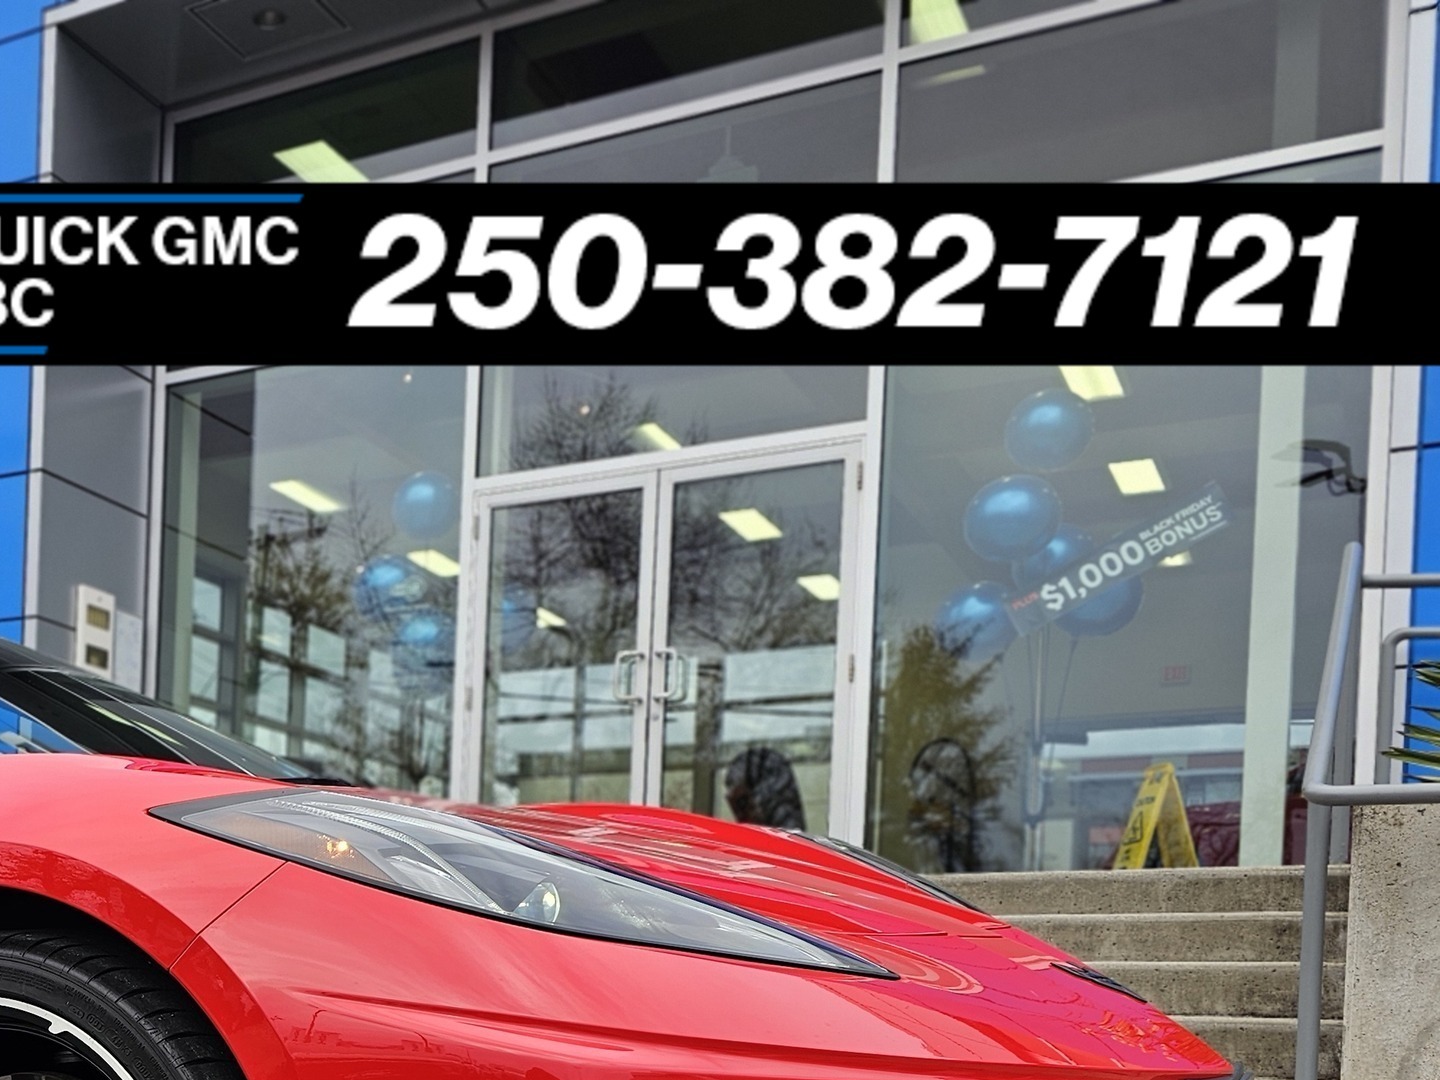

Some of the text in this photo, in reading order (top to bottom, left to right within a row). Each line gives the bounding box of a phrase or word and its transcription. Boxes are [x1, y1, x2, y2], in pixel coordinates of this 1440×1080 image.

[1138, 495, 1213, 542] BLACK FRIDAY
[1039, 539, 1146, 612] $1,000
[1143, 504, 1225, 557] BONUS
